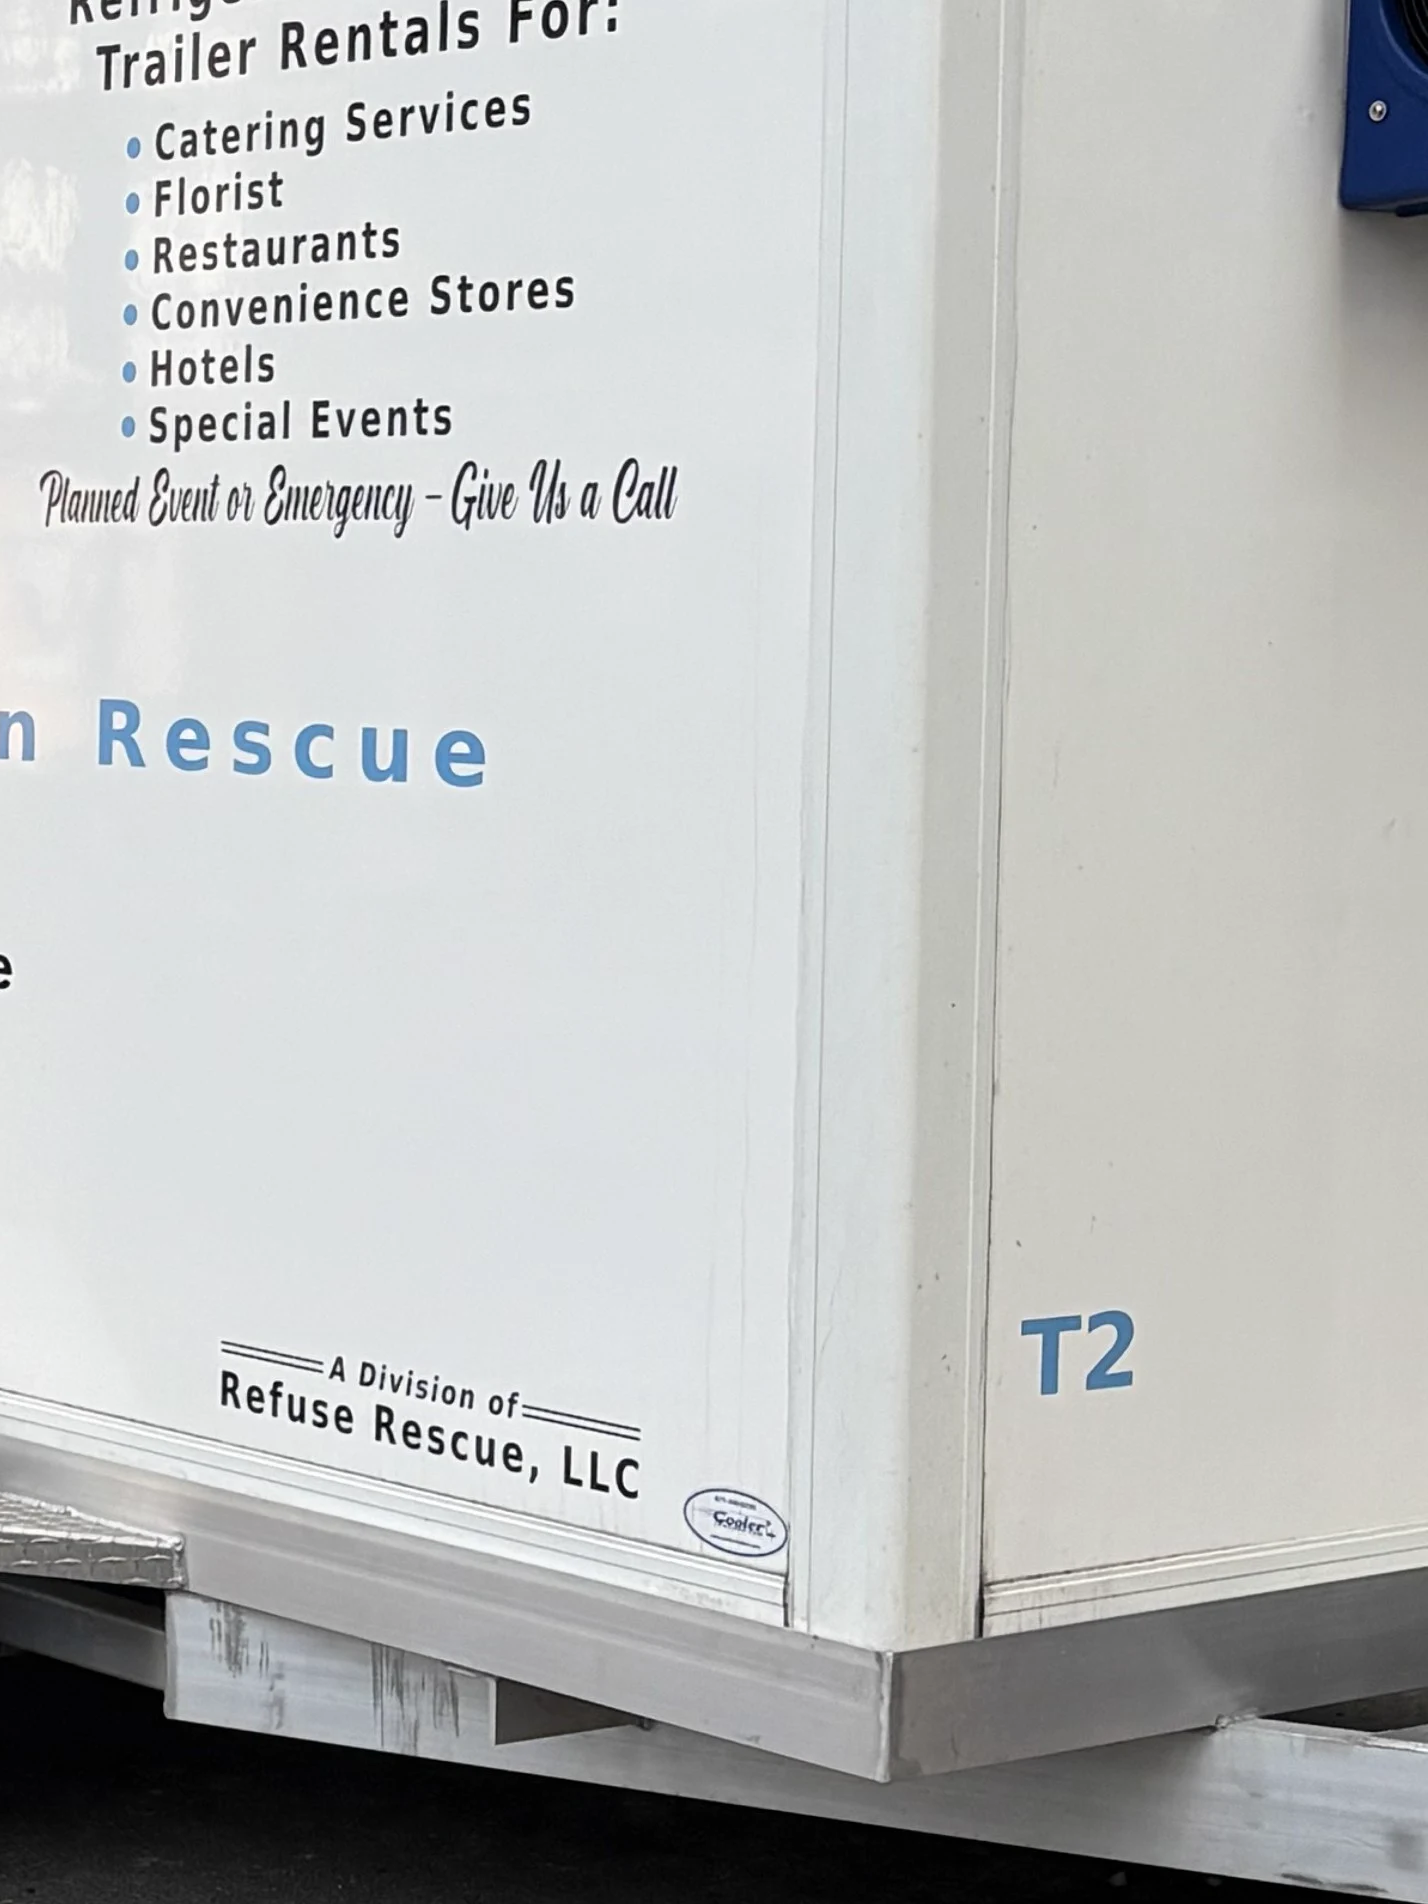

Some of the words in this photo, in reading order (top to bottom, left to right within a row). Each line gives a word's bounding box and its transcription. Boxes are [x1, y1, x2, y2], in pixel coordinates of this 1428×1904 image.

[96, 31, 257, 91] Trailer
[281, 0, 479, 70] Rentals
[155, 110, 325, 161] Catering
[346, 90, 530, 142] Services
[155, 171, 284, 218] Florist
[154, 221, 400, 274] Restaurants
[151, 282, 409, 331] Convenience
[430, 274, 574, 315] Stores
[151, 343, 274, 387] Hotels
[149, 400, 290, 453] Special
[312, 398, 452, 439] Events
[39, 469, 141, 528] Planned
[148, 467, 220, 527] Event
[226, 482, 252, 522] or
[264, 464, 413, 539] Emergency
[451, 460, 516, 531] Give
[529, 458, 567, 525] Us
[580, 482, 599, 520] a
[612, 457, 678, 524] Call
[96, 697, 490, 788] Rescue
[1020, 1310, 1135, 1396] T2
[328, 1356, 345, 1382] A
[359, 1361, 475, 1410] Division
[488, 1391, 520, 1419] of
[221, 1368, 355, 1436] Refuse
[373, 1405, 539, 1485] Rescue,
[563, 1445, 639, 1499] LLC
